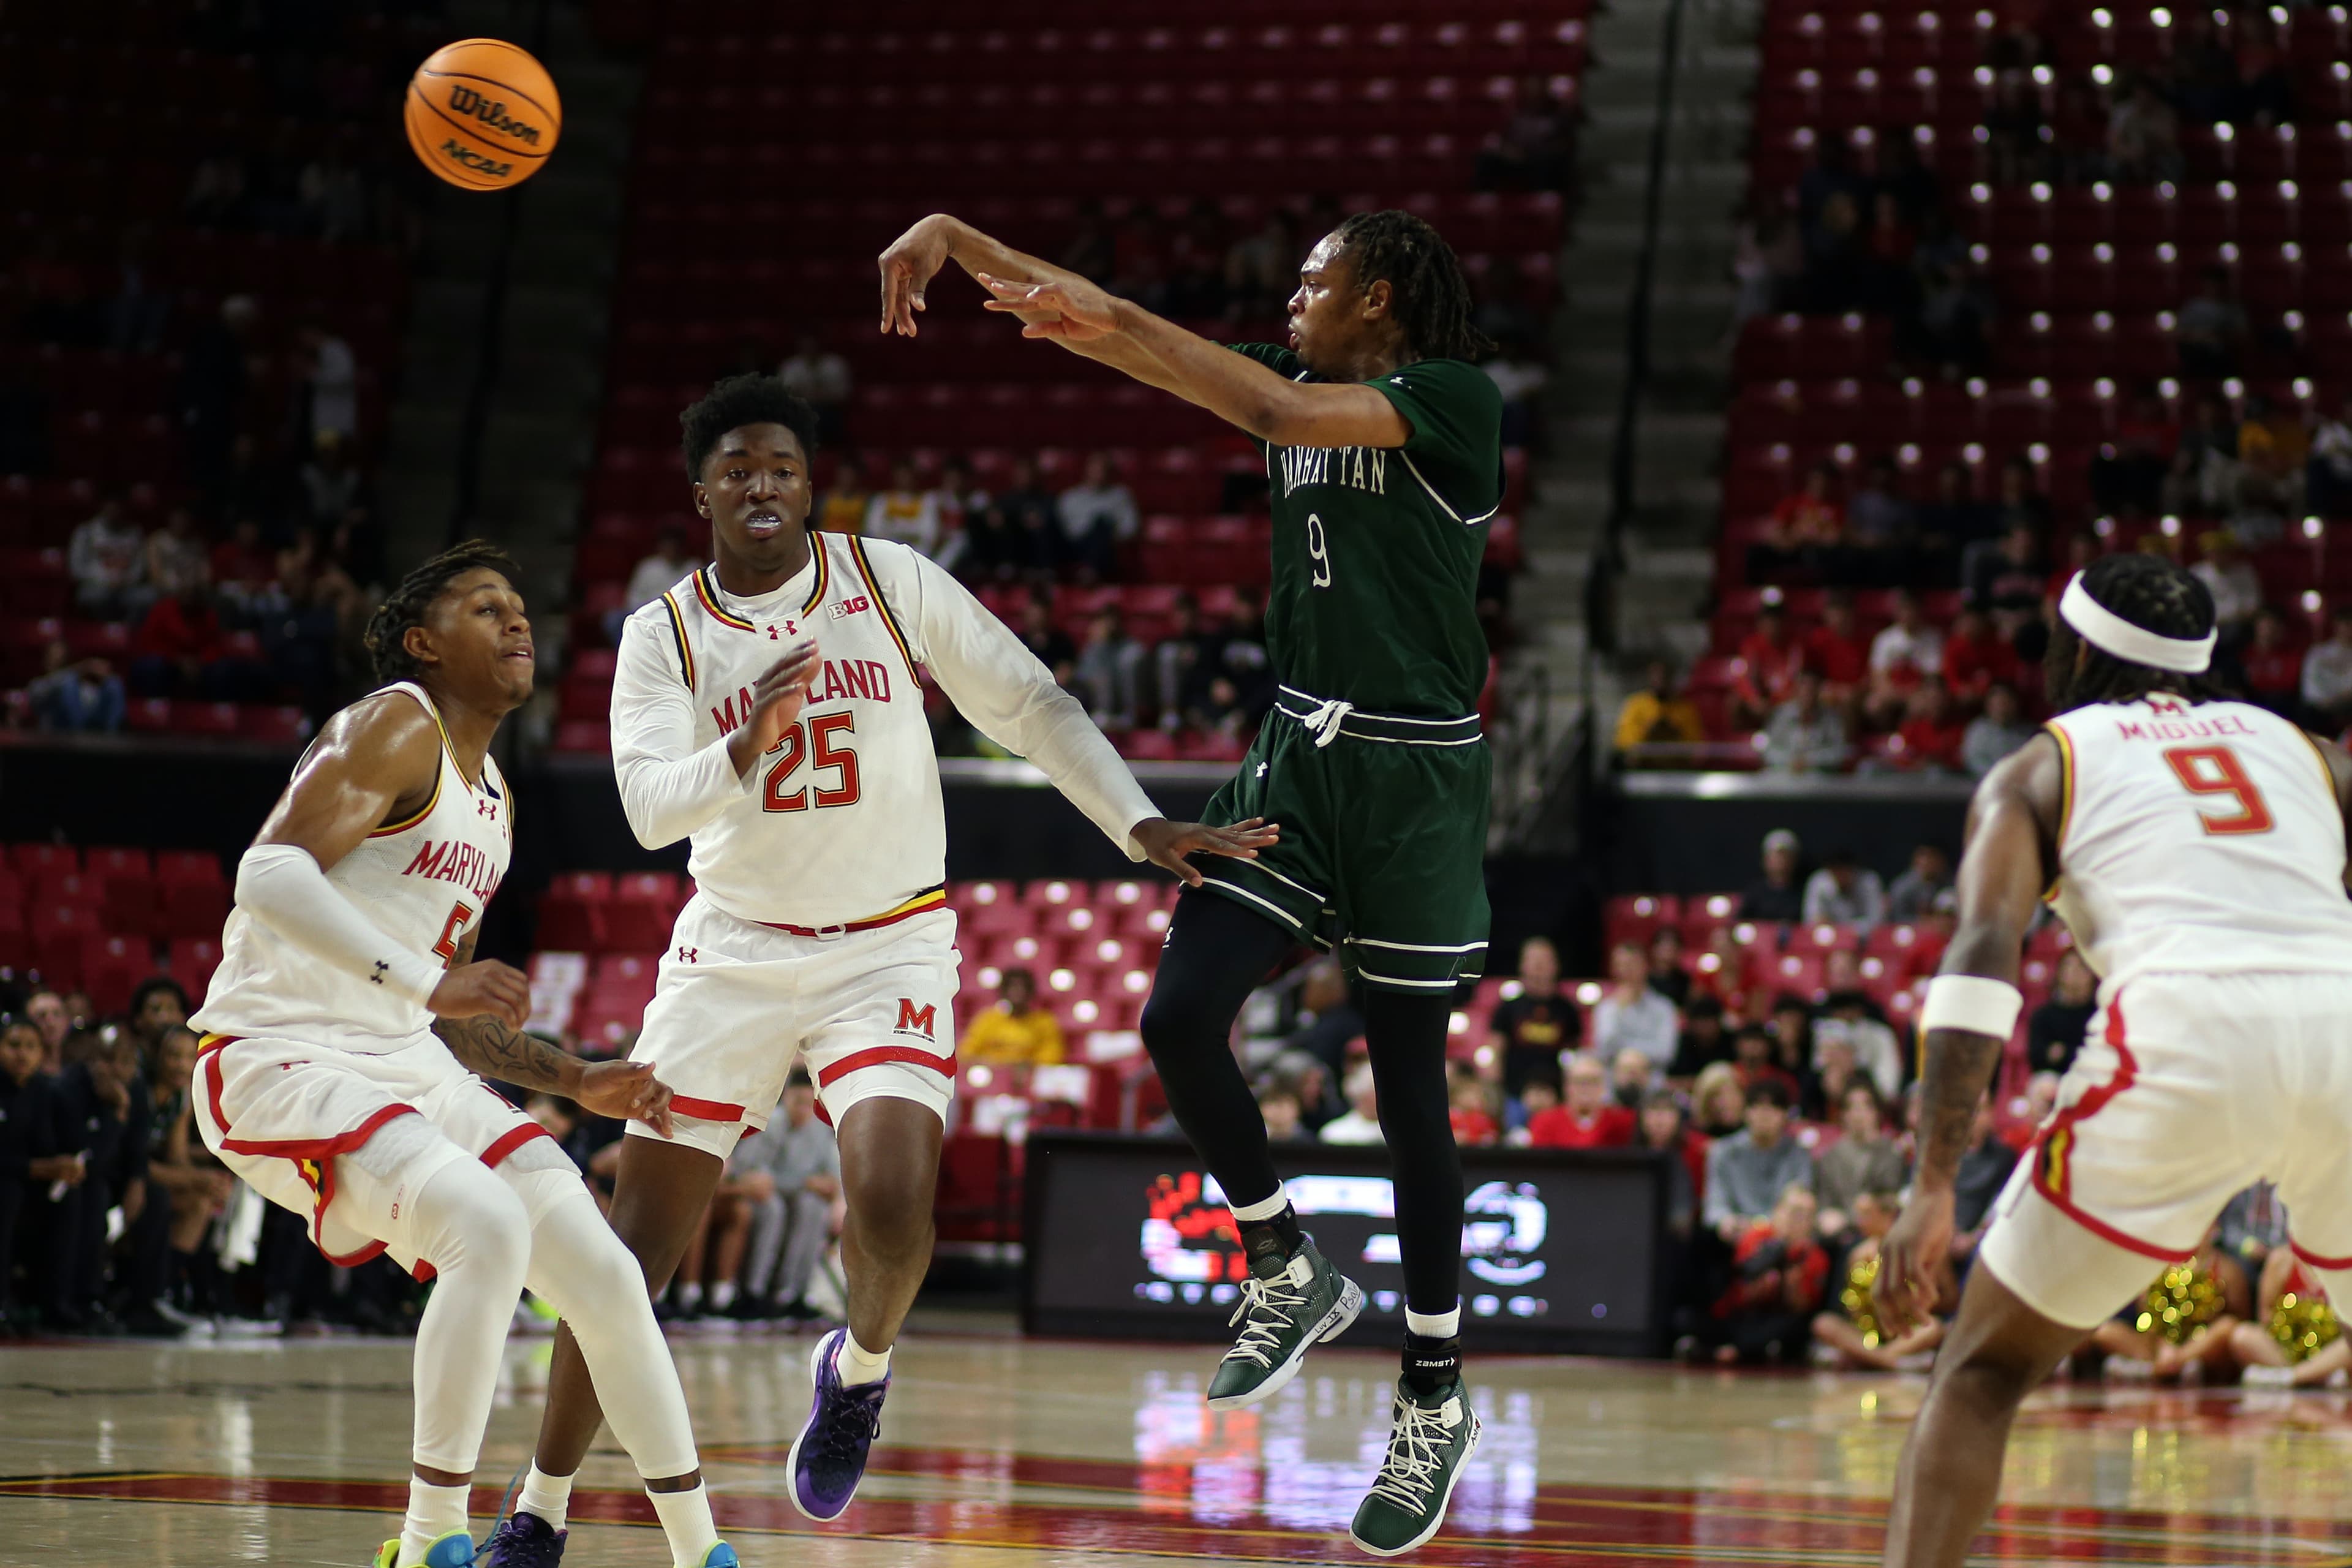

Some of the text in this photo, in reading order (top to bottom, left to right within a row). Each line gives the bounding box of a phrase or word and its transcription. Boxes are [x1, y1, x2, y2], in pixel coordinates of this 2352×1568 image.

[451, 85, 541, 146] Wilson
[441, 138, 514, 178] NCAA
[1307, 513, 1332, 588] 9
[711, 659, 891, 737] MALAND
[2116, 715, 2257, 741] MIGUEL
[763, 710, 861, 813] 25
[2163, 744, 2276, 836] 9
[894, 998, 937, 1038] M
